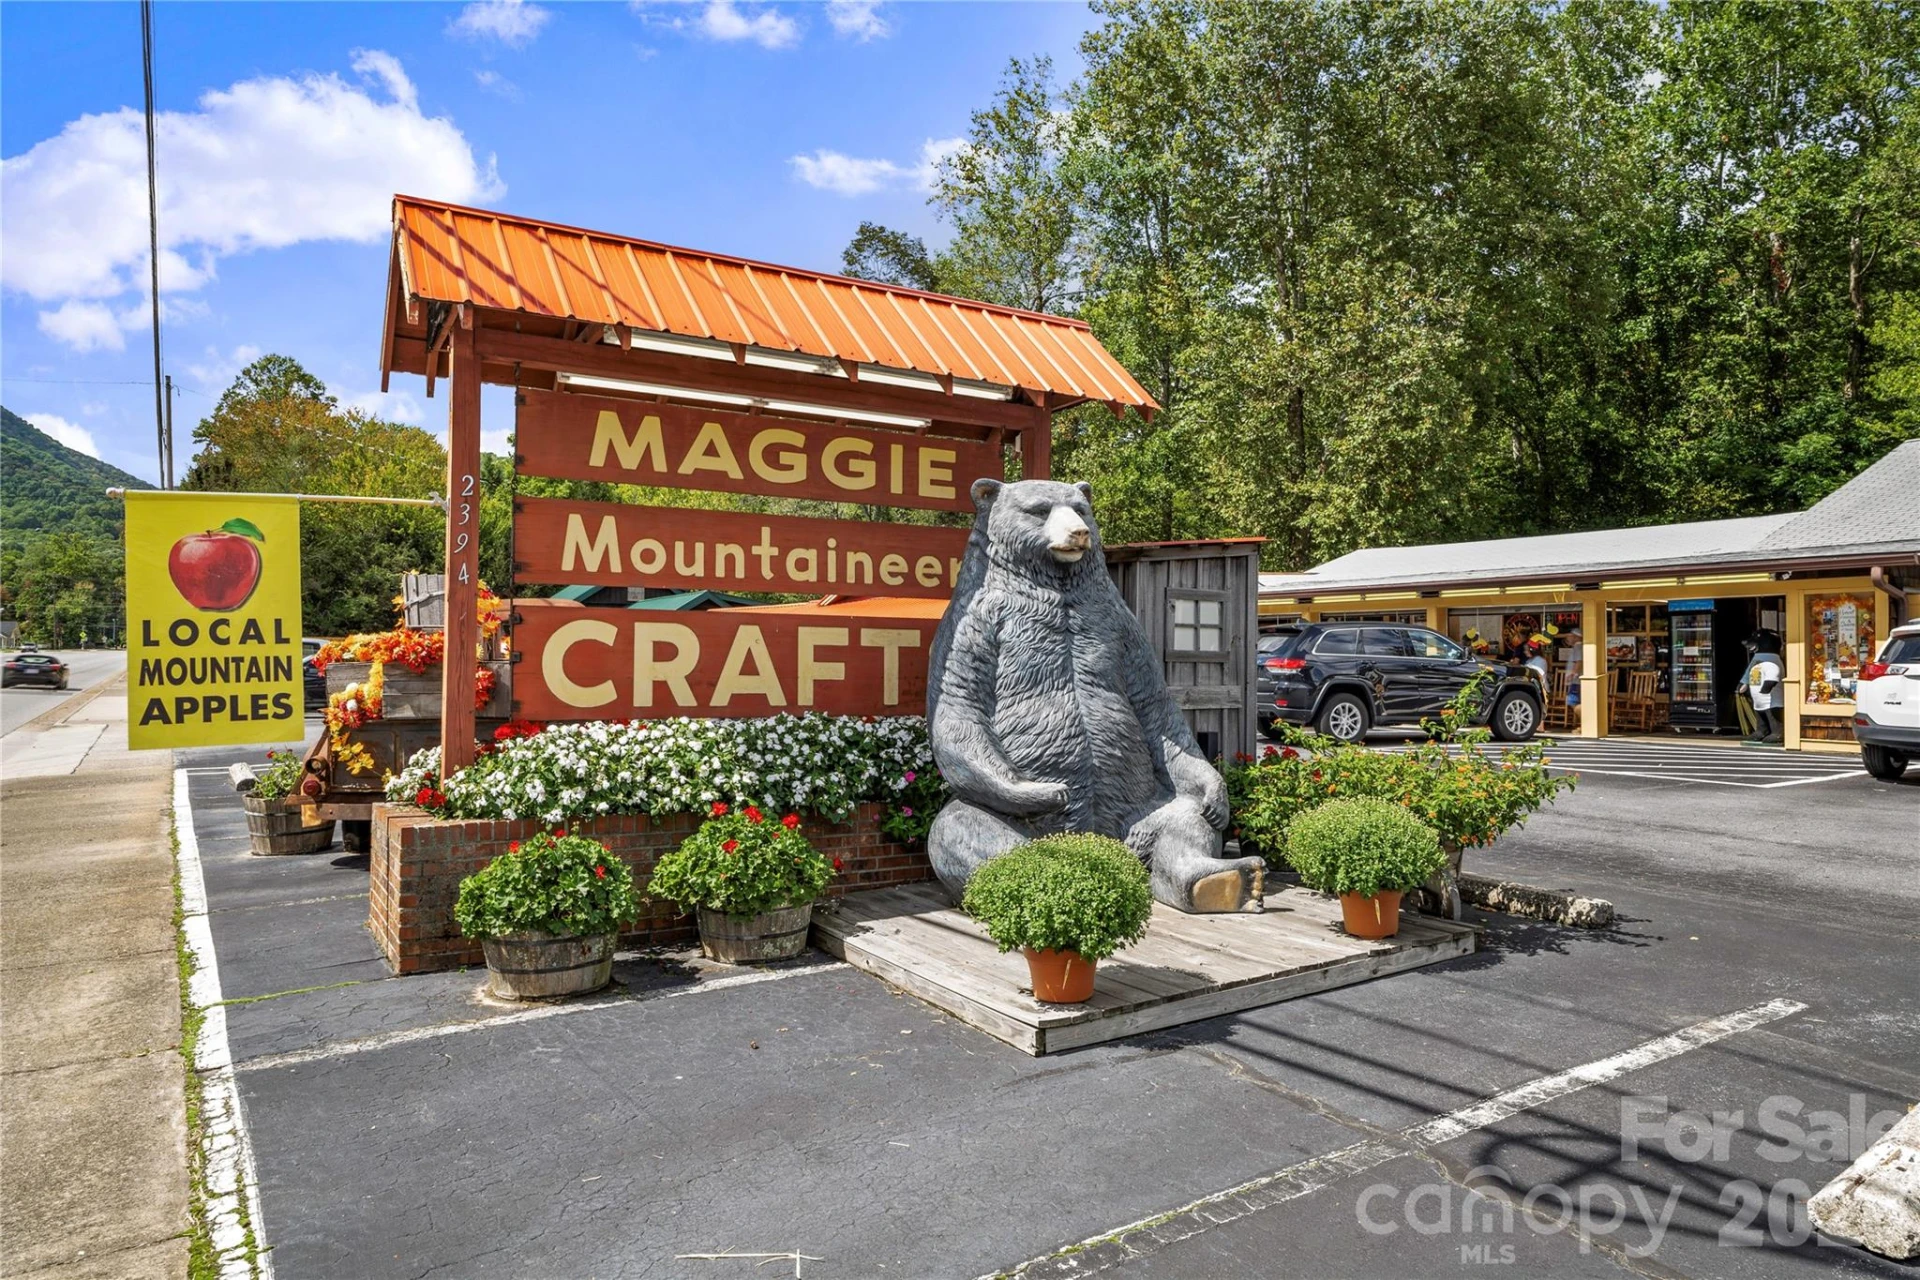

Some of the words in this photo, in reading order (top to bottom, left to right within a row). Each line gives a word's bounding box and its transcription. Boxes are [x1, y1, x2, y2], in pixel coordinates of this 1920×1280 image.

[588, 410, 957, 500] MAGGIE
[453, 474, 475, 585] 2394
[561, 513, 963, 588] Mountaineer
[142, 617, 291, 647] LOCAL
[541, 619, 934, 709] CRAFT
[138, 655, 293, 686] MOUNTAIN
[138, 692, 293, 726] APPLES
